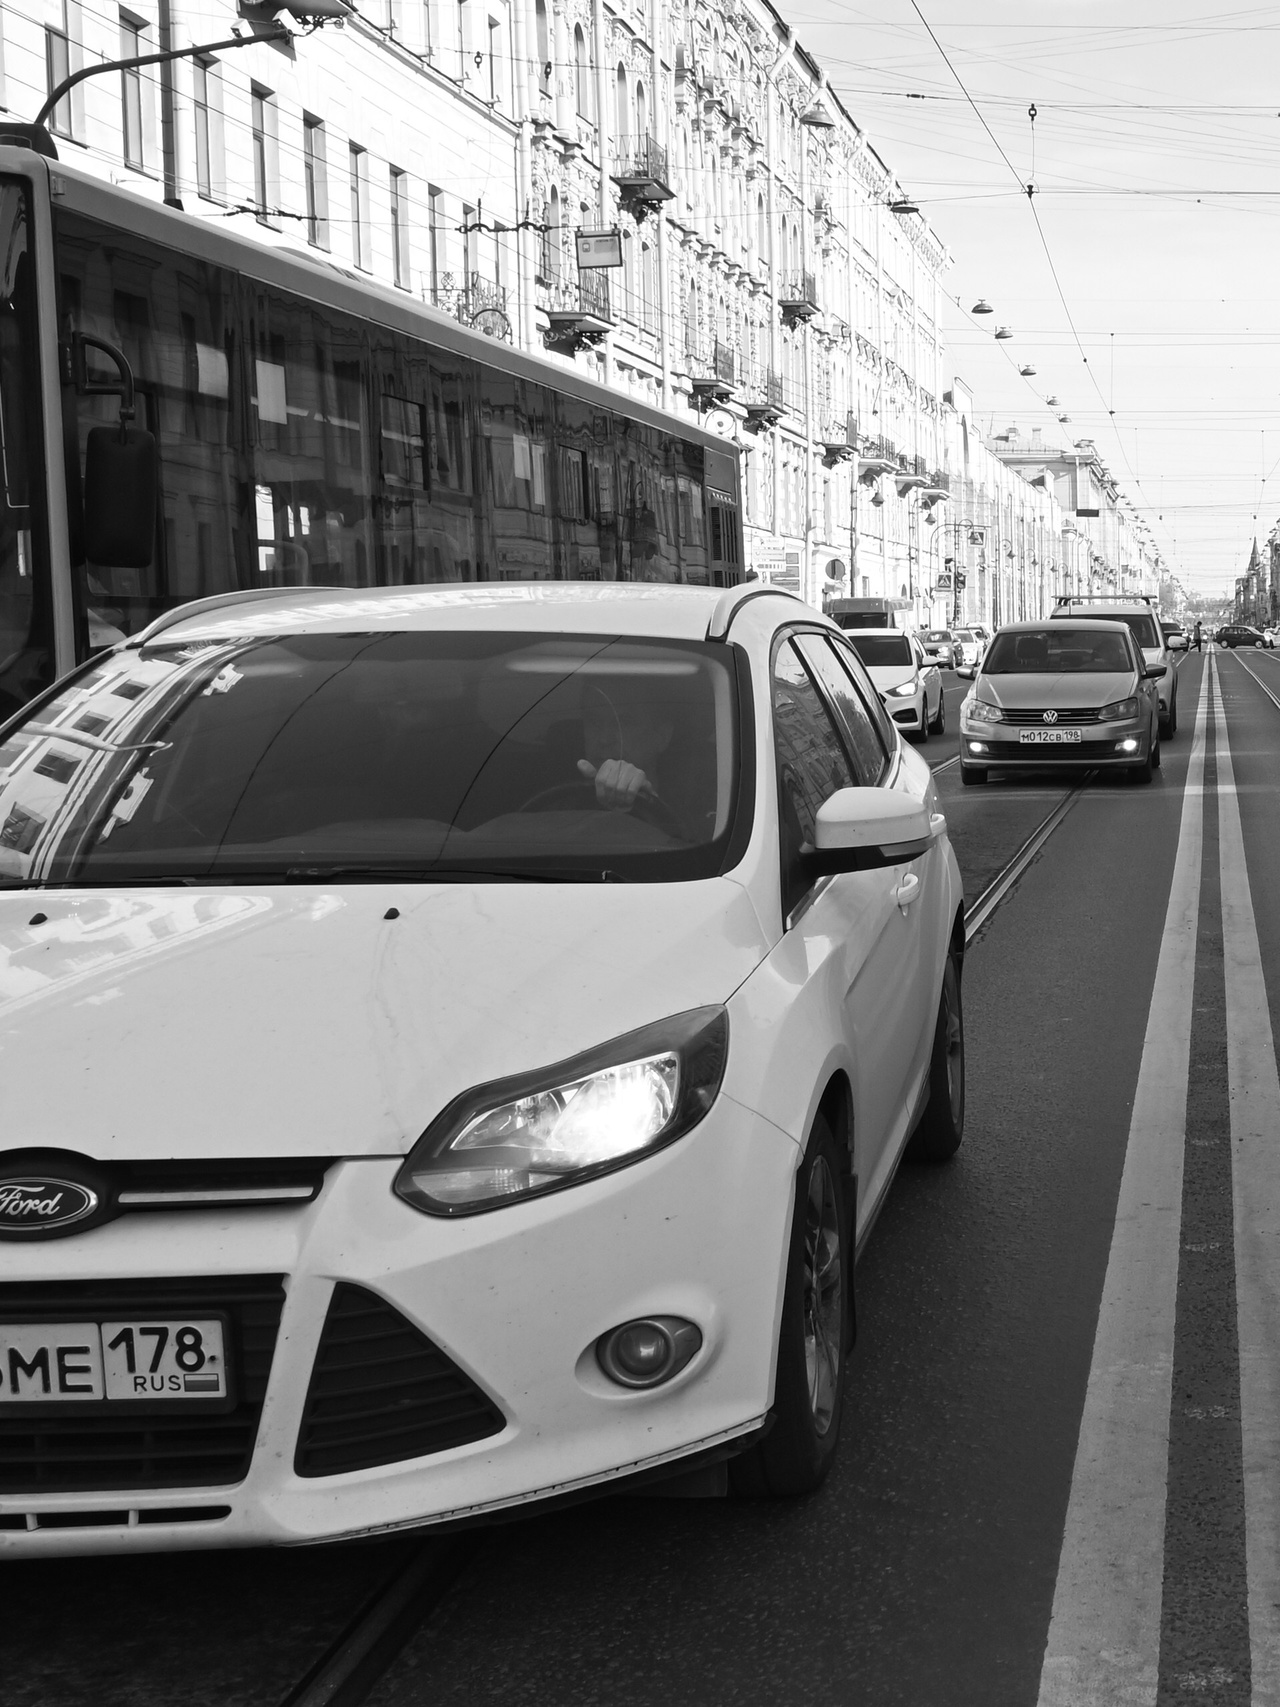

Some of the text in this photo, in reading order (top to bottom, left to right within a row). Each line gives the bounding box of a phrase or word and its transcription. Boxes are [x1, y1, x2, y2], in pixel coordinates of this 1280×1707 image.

[0, 1185, 63, 1216] Ford
[0, 1345, 94, 1394] МЕ
[108, 1326, 206, 1374] 178
[133, 1374, 181, 1392] RUS
